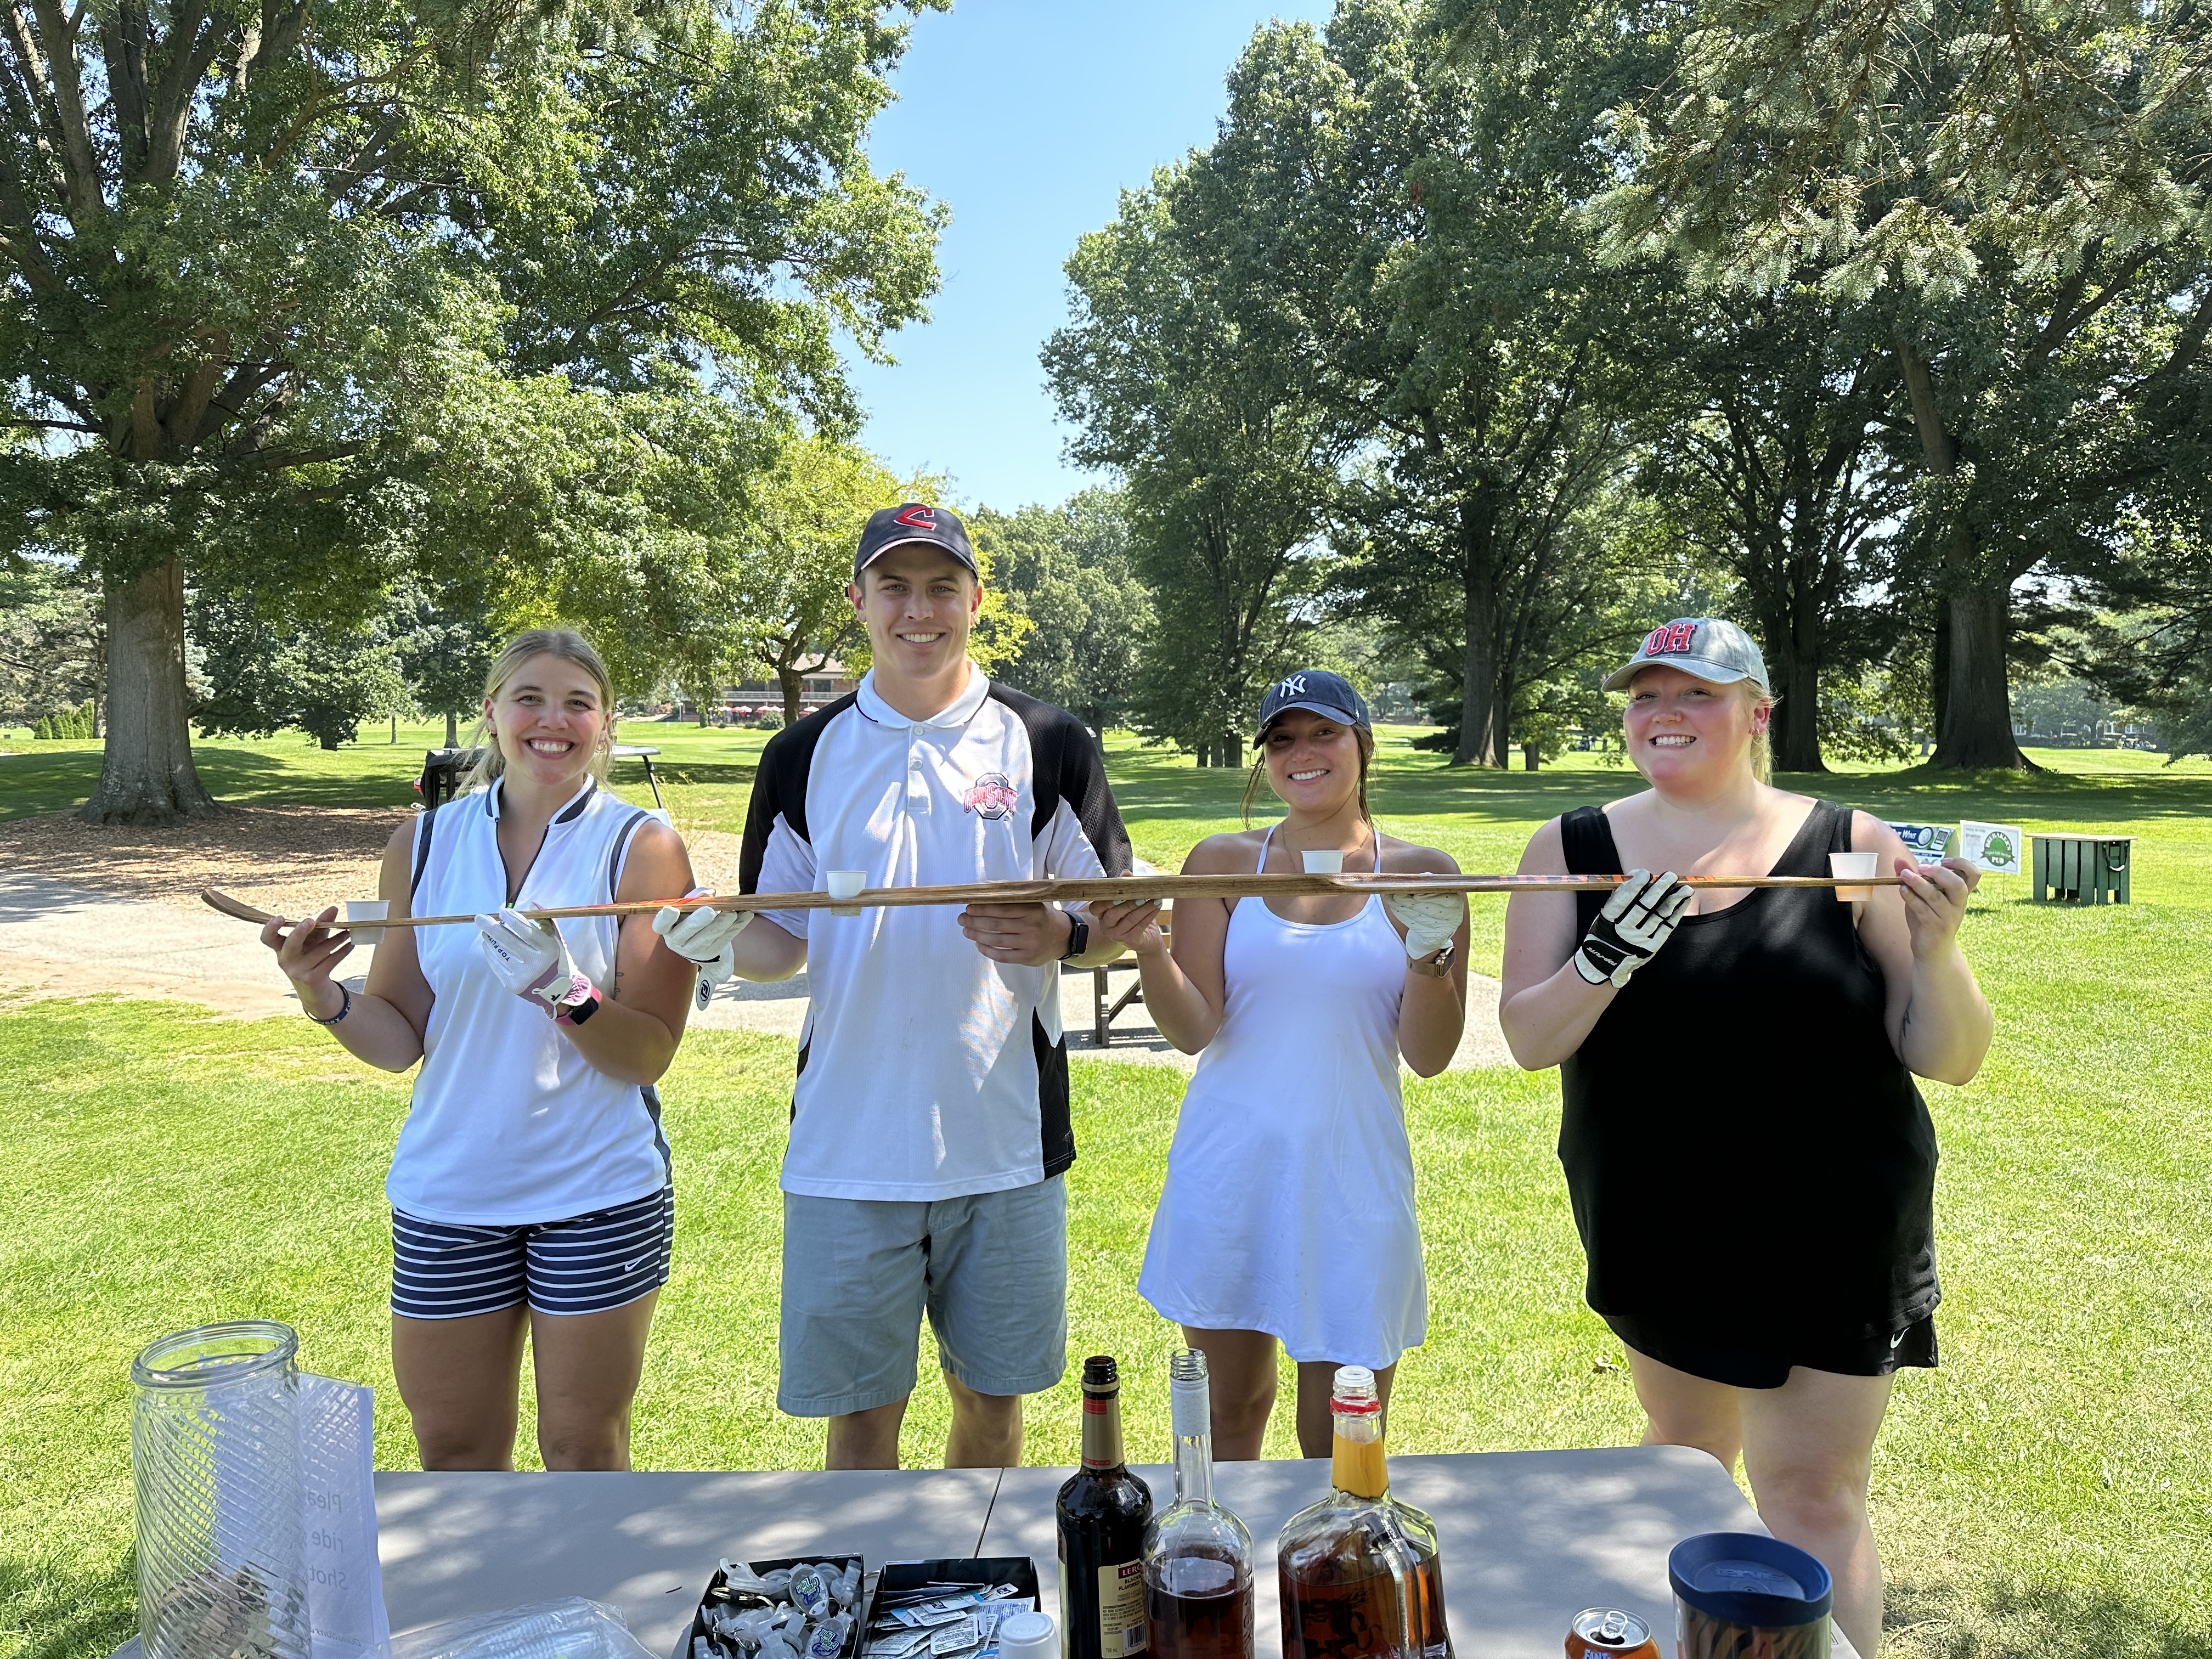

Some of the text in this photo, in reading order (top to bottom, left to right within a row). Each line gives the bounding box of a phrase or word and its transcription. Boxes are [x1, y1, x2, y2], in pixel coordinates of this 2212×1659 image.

[894, 505, 936, 531] C
[1646, 623, 1696, 656] OH
[1280, 675, 1306, 698] NY
[964, 782, 1018, 816] OHIO STATE
[1712, 1565, 1785, 1582] tervis
[1584, 1649, 1611, 1659] FANT
